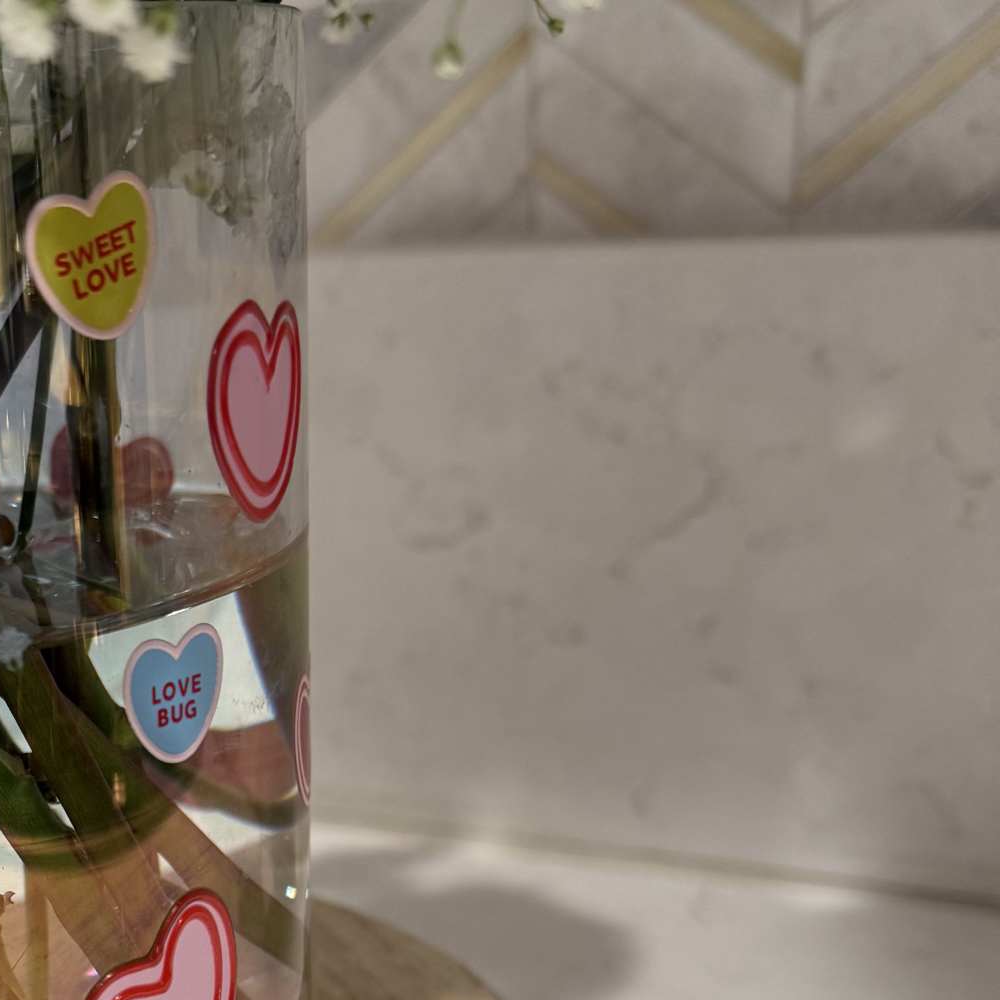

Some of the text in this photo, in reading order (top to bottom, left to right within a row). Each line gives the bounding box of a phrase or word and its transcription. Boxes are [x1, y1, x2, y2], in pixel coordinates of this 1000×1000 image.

[54, 220, 136, 277] SWEET
[72, 252, 136, 300] LOVE
[151, 673, 201, 706] LOVE
[157, 700, 197, 729] BUG
